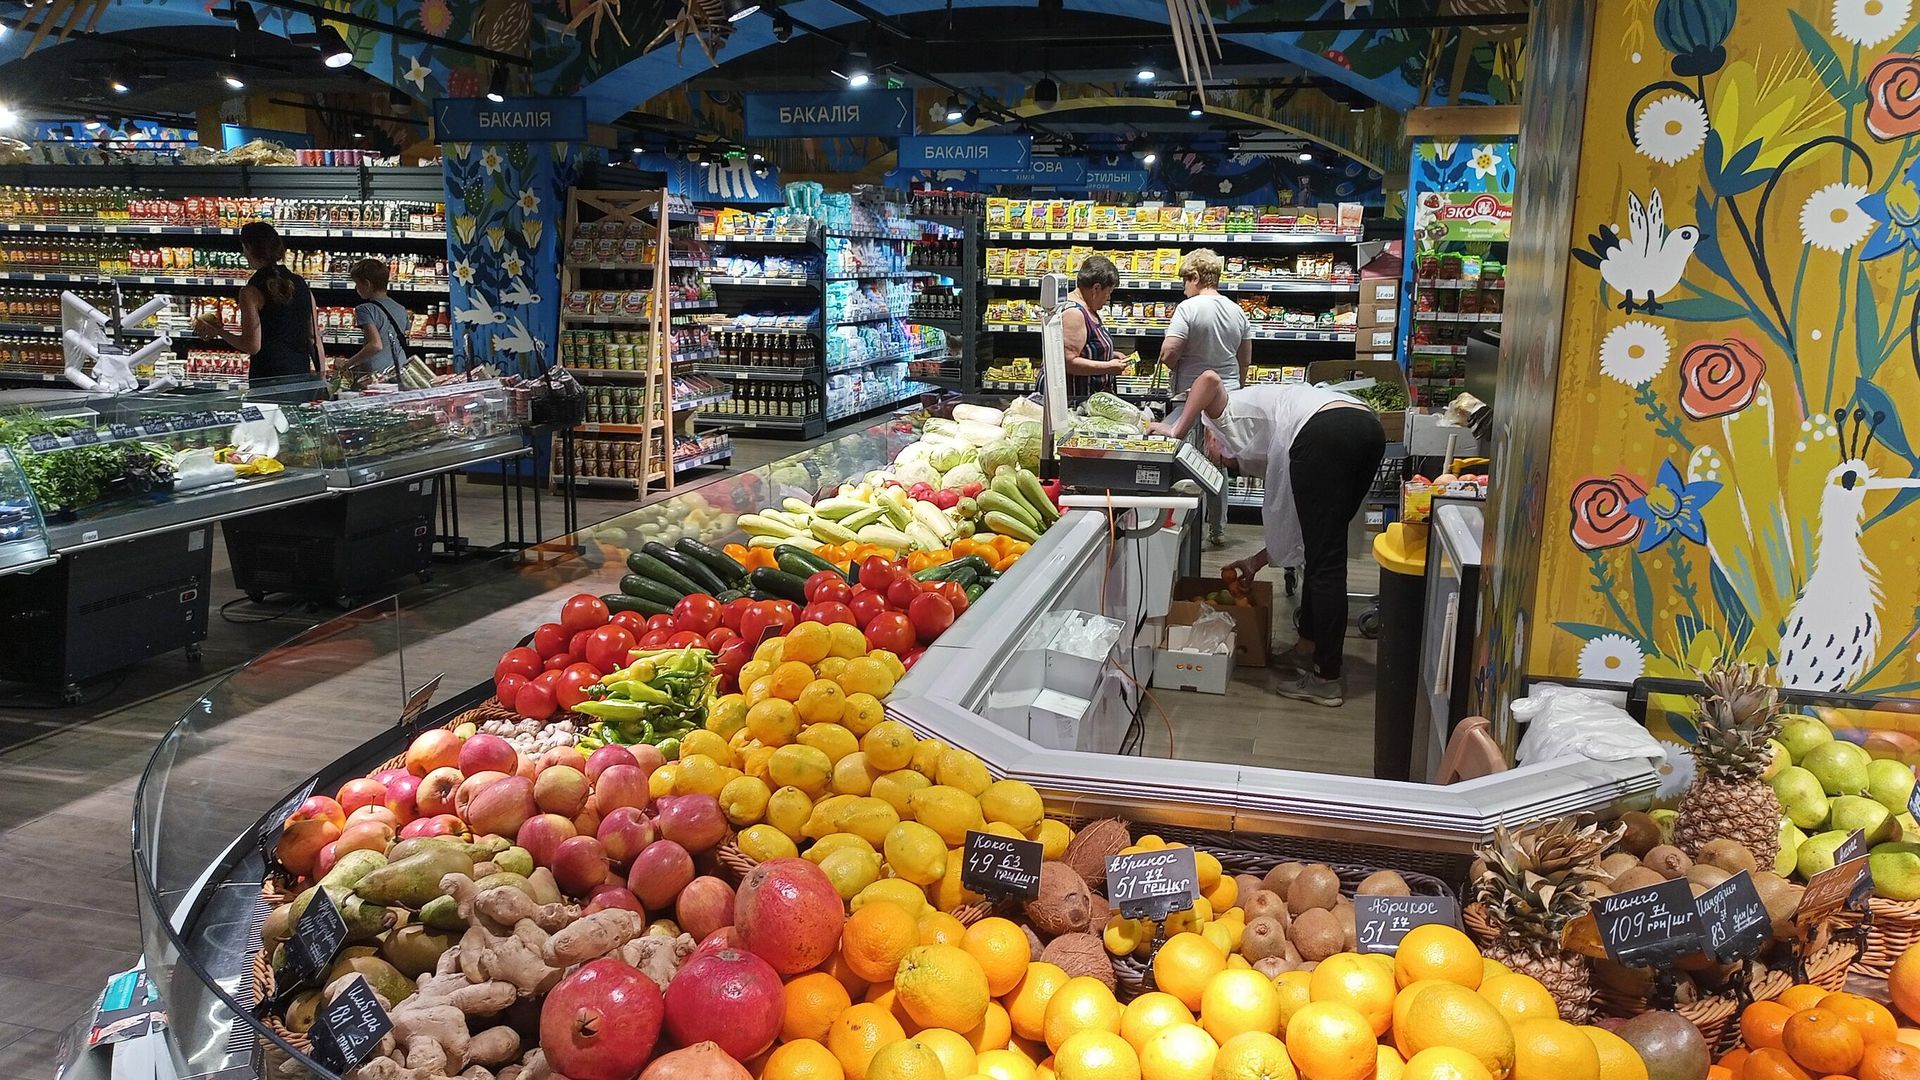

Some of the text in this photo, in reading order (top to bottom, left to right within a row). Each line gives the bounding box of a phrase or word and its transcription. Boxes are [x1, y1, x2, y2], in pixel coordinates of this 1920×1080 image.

[479, 111, 551, 128] БАКАЛІЯ
[780, 106, 860, 124] БАКАЛІЯ
[925, 146, 989, 159] БАКАЛІЯ
[973, 835, 1016, 852] Кокос
[969, 852, 1021, 873] 49 63
[1108, 853, 1178, 875] Абрикос
[1114, 867, 1164, 899] 51 77
[1368, 898, 1439, 916] Абрикос
[1601, 891, 1659, 916] Манго
[1360, 916, 1411, 944] 51 77
[1609, 903, 1666, 945] 109 71
[1711, 922, 1726, 947] 83
[329, 1004, 354, 1030] 181
[348, 984, 382, 1033] Имбирь
